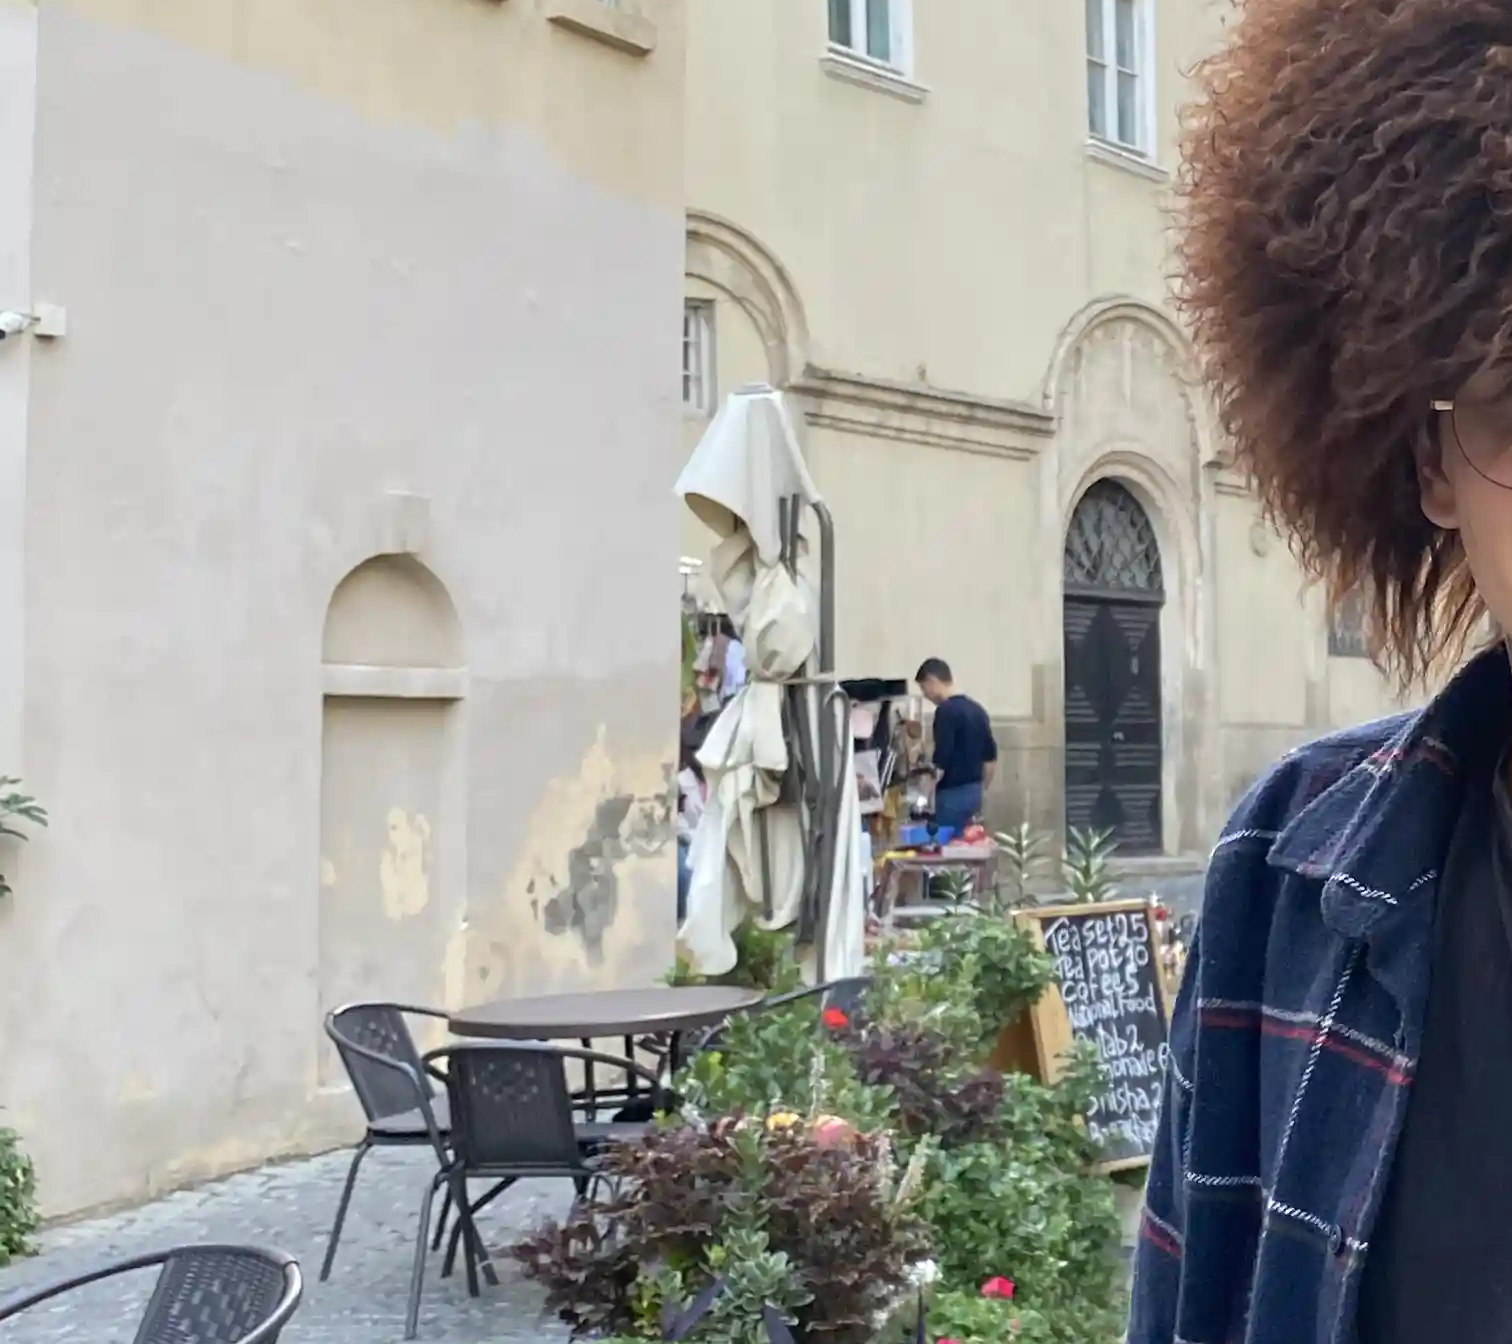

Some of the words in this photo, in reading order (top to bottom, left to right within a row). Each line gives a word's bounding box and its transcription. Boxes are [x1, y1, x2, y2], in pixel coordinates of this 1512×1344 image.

[1044, 916, 1082, 956] Tea
[1082, 915, 1117, 948] set
[1115, 913, 1148, 947] 25
[1124, 962, 1140, 995] 5
[1126, 1023, 1145, 1053] 2
